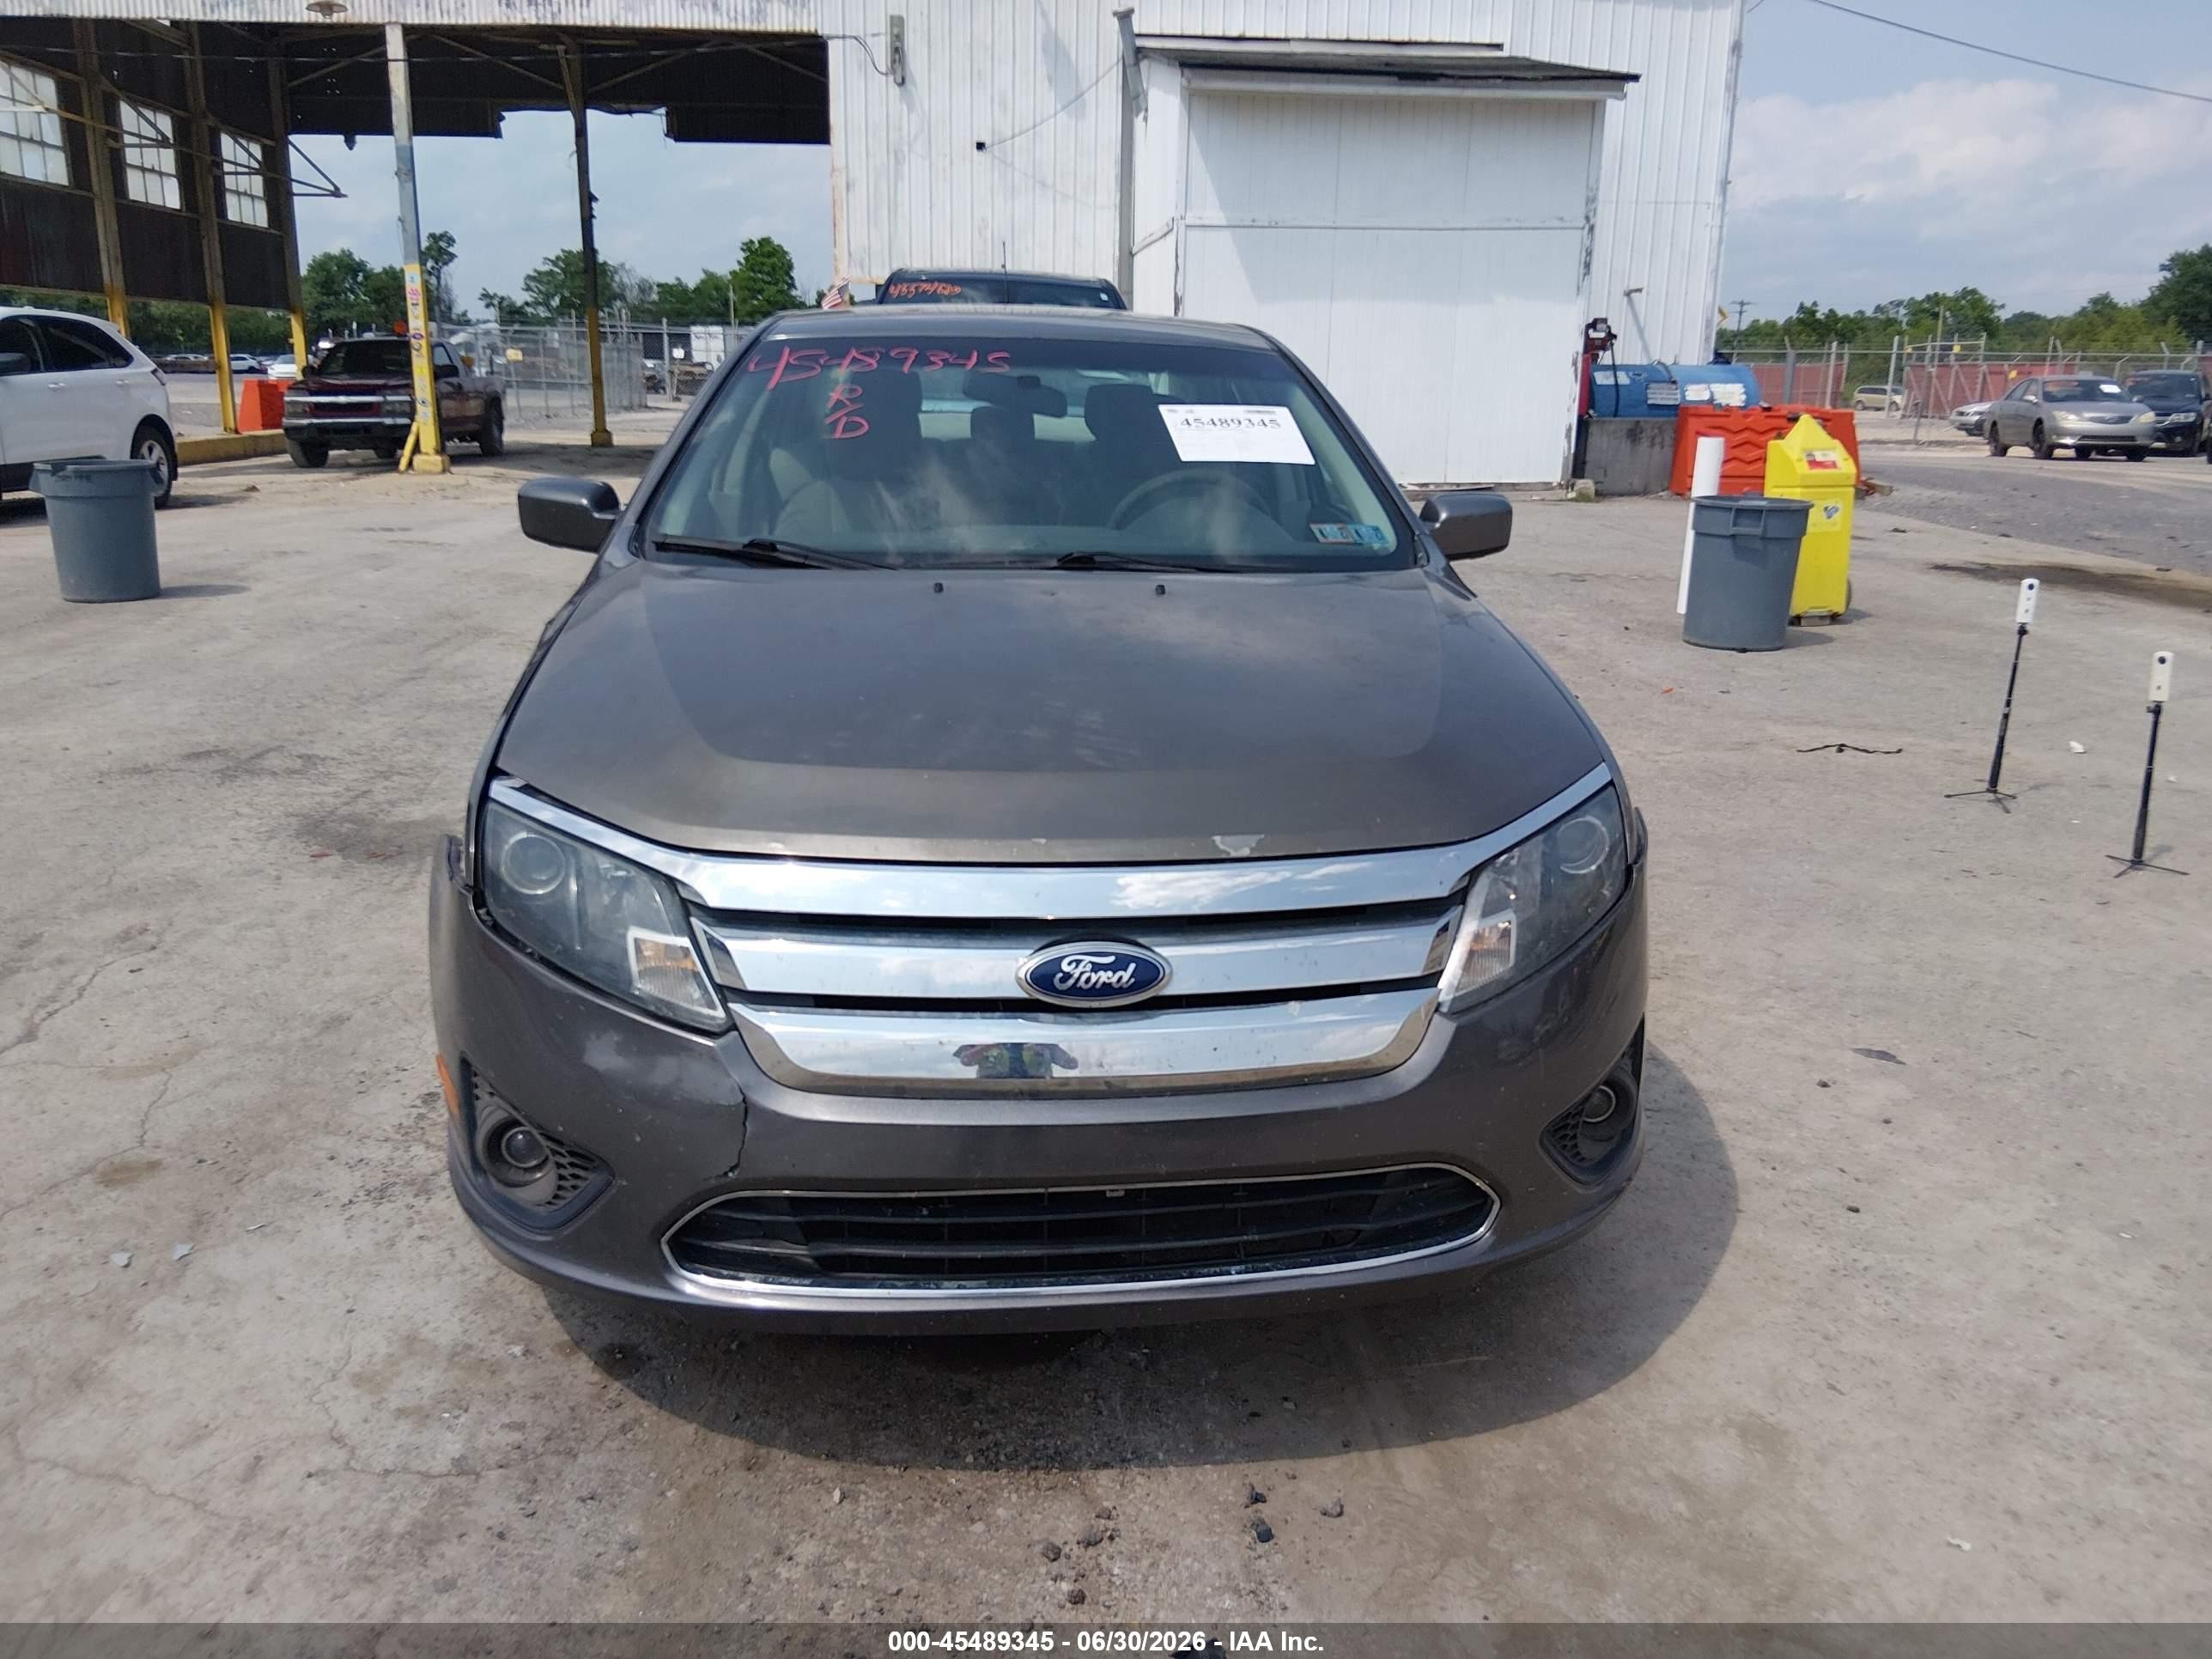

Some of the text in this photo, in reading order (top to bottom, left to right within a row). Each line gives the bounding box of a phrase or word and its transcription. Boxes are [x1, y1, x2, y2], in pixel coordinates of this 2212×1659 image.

[747, 345, 1011, 391] 45489345
[1181, 417, 1281, 429] 45489345
[1054, 955, 1137, 990] Ford
